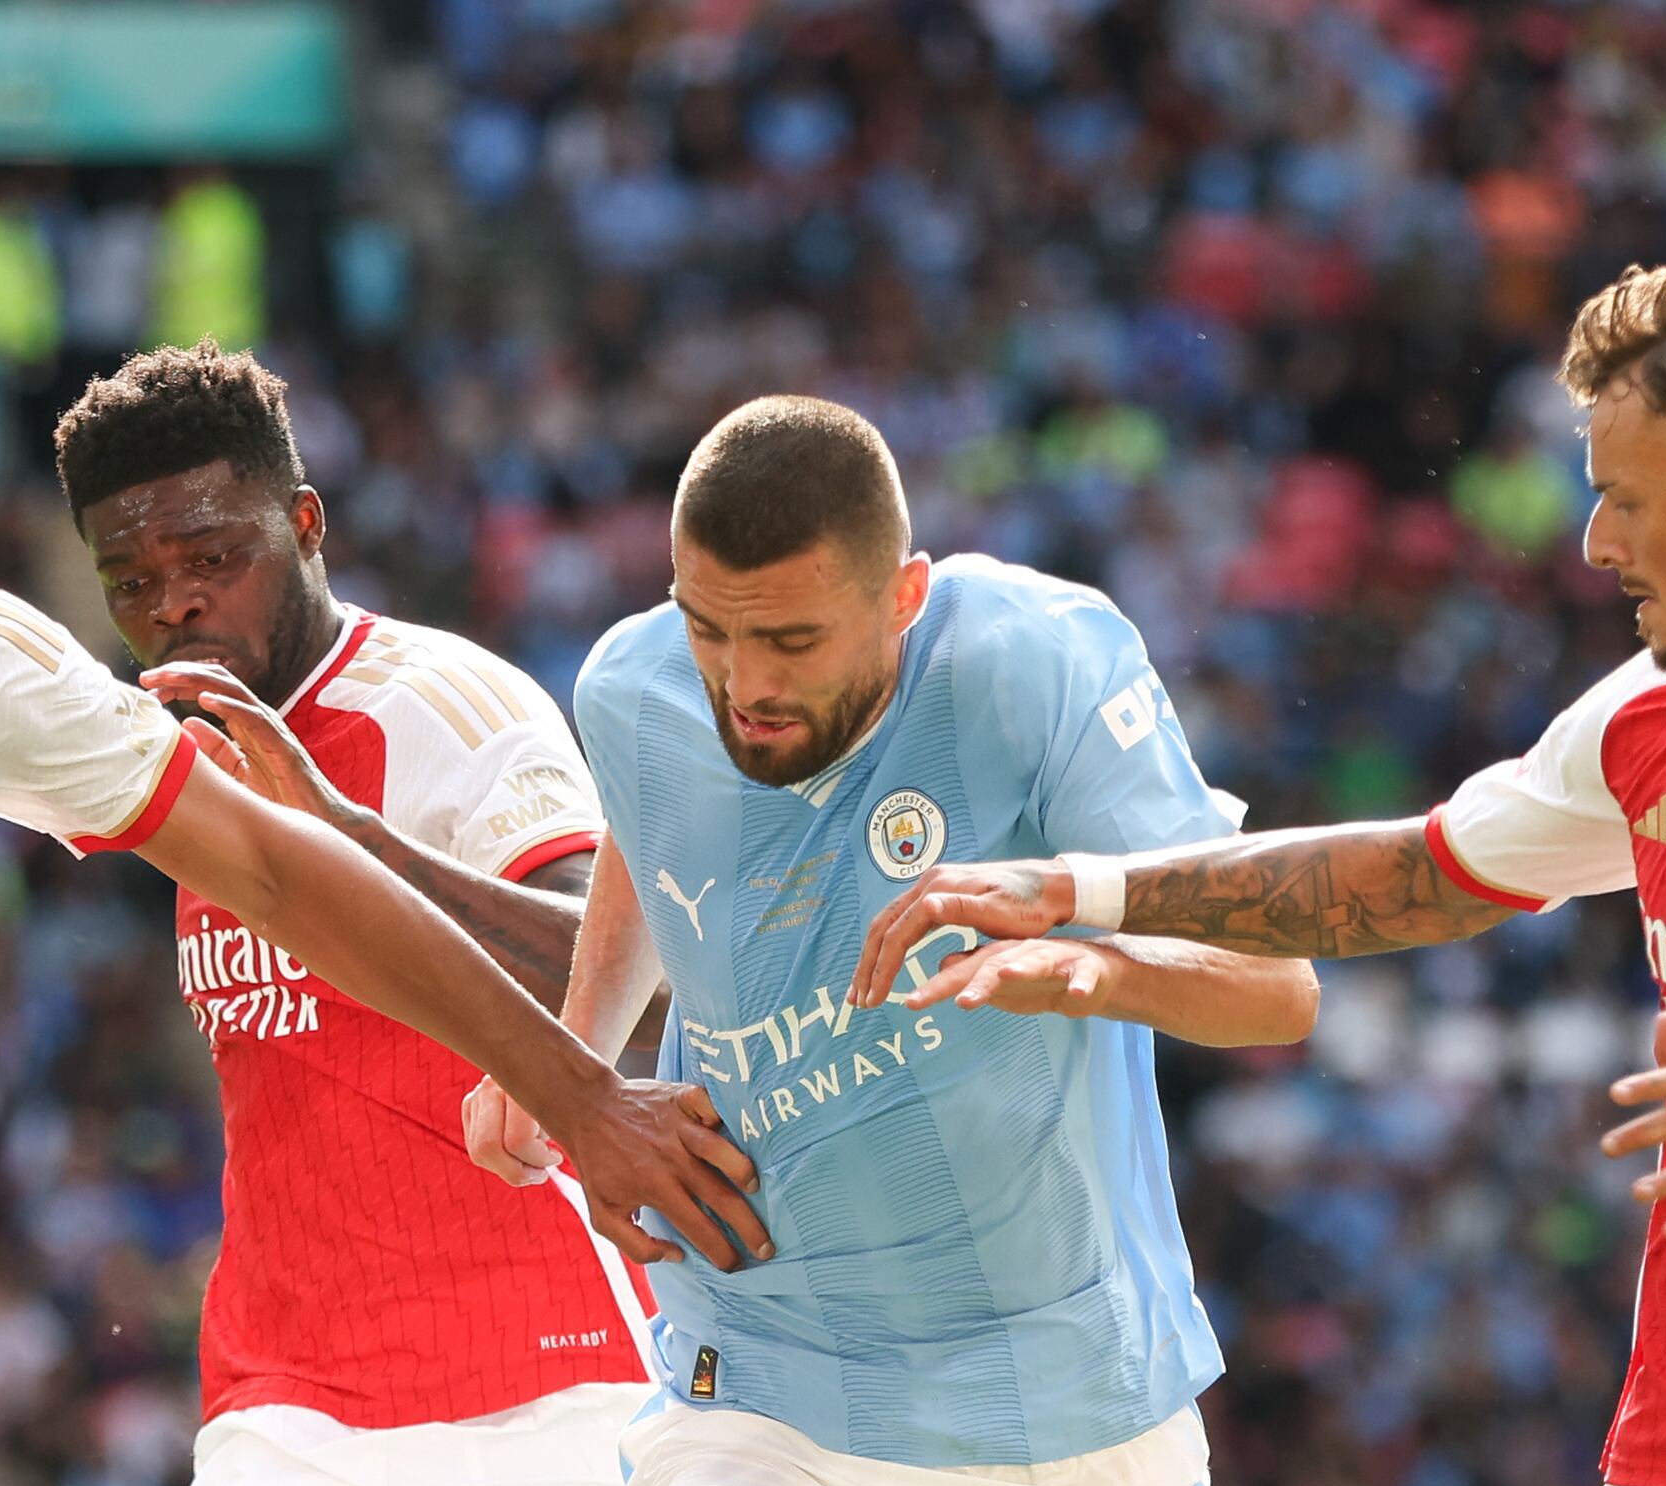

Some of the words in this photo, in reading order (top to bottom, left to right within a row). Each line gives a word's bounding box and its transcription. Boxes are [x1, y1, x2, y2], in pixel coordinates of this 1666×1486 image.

[873, 794, 935, 832] MANCHESTER
[899, 862, 925, 877] CITY
[177, 913, 309, 995] mirate
[740, 1015, 943, 1143] AIRWAYS
[539, 1328, 608, 1352] HEAT.RDY
